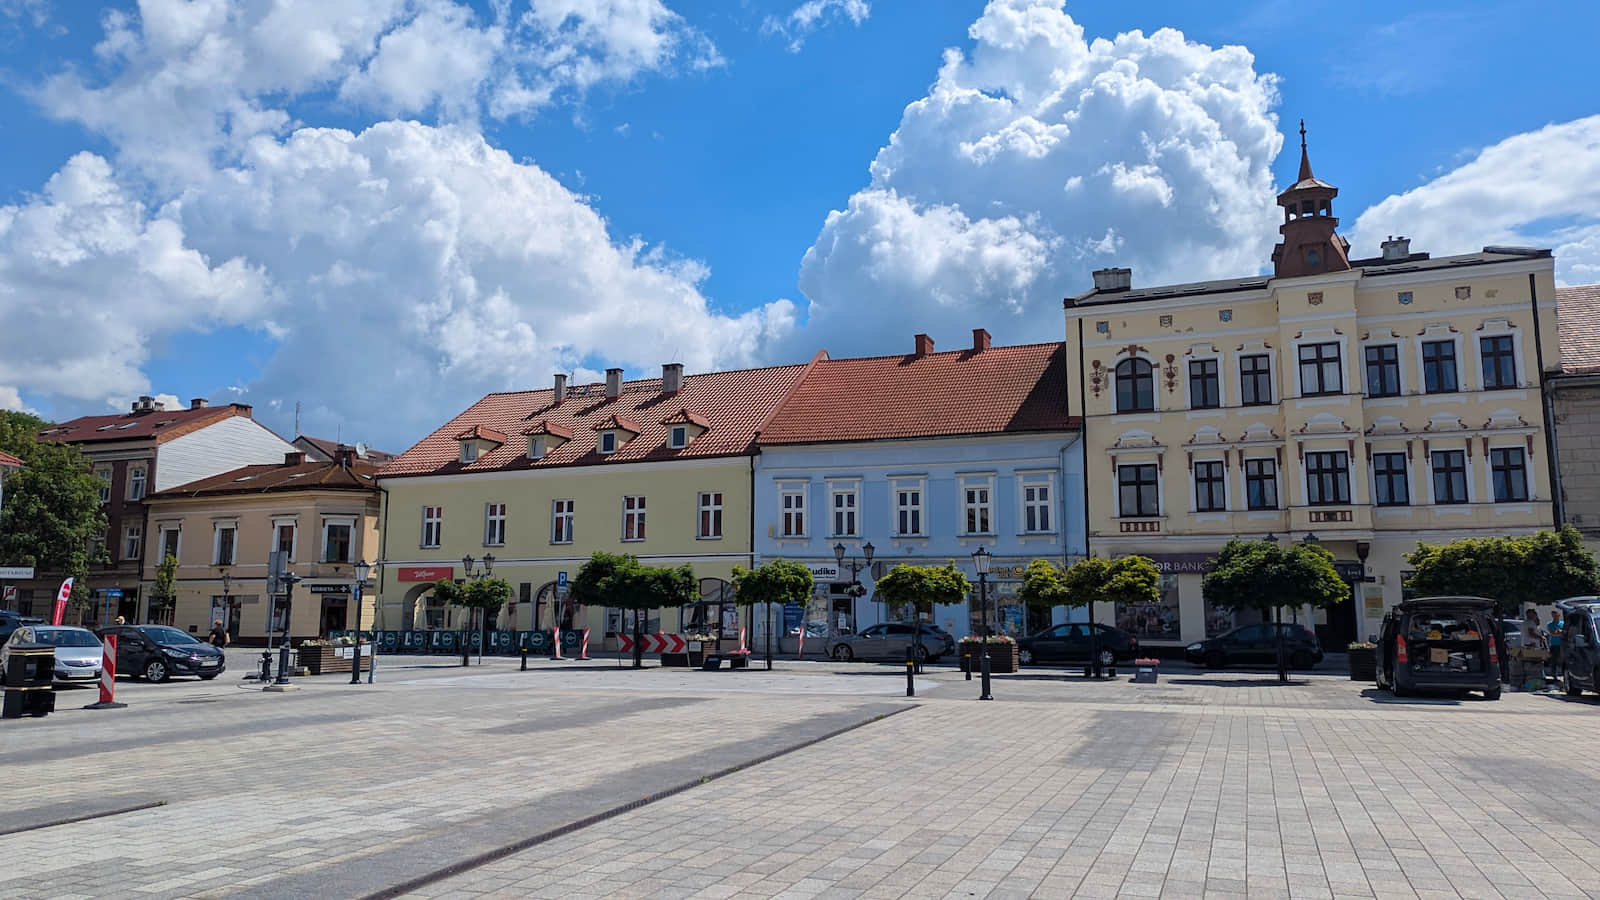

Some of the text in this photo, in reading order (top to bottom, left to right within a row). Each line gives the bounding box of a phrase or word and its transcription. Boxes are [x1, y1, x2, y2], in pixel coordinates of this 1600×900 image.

[1174, 562, 1205, 571] BANK
[809, 567, 837, 576] udika
[559, 573, 566, 585] P
